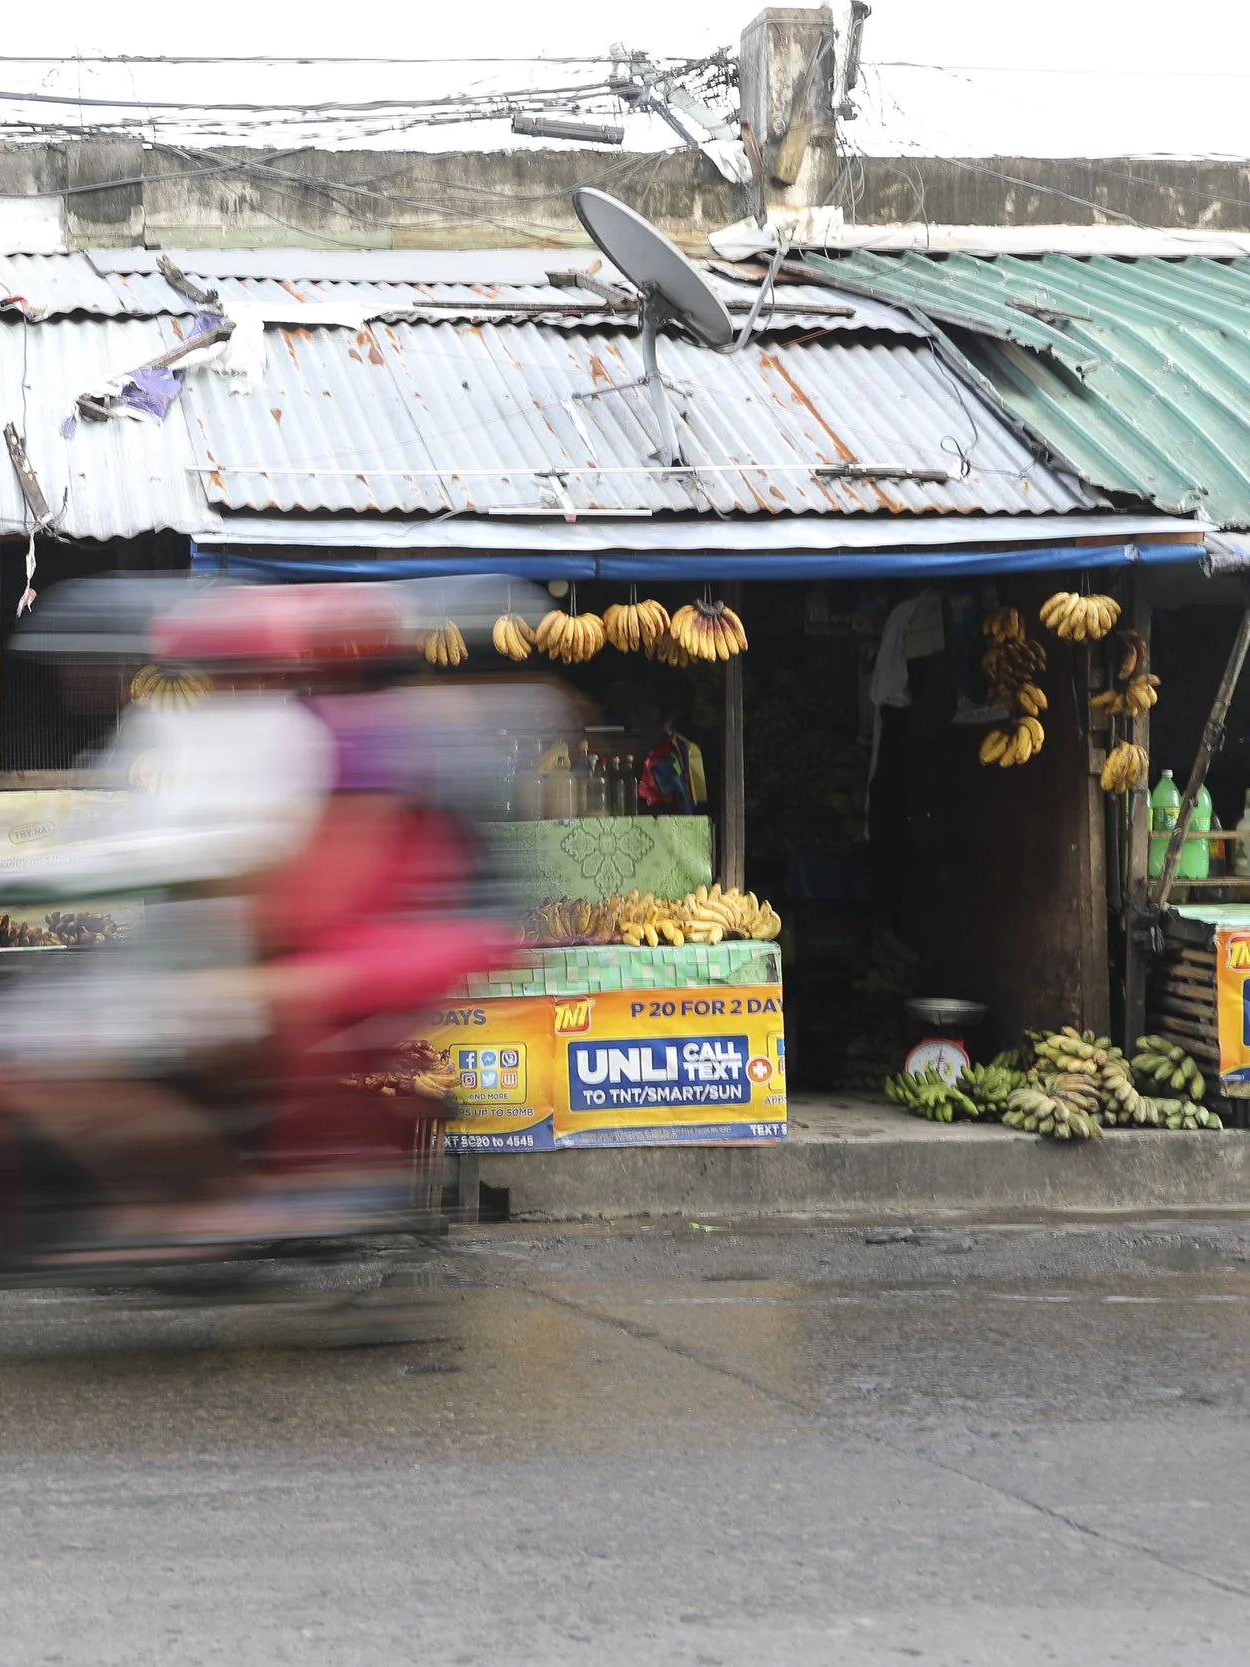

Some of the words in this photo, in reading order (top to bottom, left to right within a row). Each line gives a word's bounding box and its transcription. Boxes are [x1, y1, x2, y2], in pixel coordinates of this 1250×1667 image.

[13, 830, 31, 840] TRY
[1230, 941, 1250, 967] TN
[554, 1000, 591, 1031] TNT
[631, 1002, 645, 1018] P
[649, 1001, 676, 1017] 20
[681, 1000, 726, 1016] FOR
[730, 1000, 743, 1015] 2
[576, 1046, 678, 1084] UNLI
[683, 1041, 743, 1063] CALL
[683, 1060, 743, 1082] TEXT
[469, 1093, 486, 1101] AND
[487, 1092, 509, 1100] MORE
[583, 1088, 606, 1105] TO
[610, 1084, 742, 1105] TNT/SMART/SUN
[474, 1108, 488, 1117] UP
[491, 1108, 504, 1117] TO
[506, 1107, 535, 1116] 50MB
[750, 1123, 780, 1136] TEXT
[492, 1135, 504, 1147] to
[506, 1135, 535, 1147] 4545
